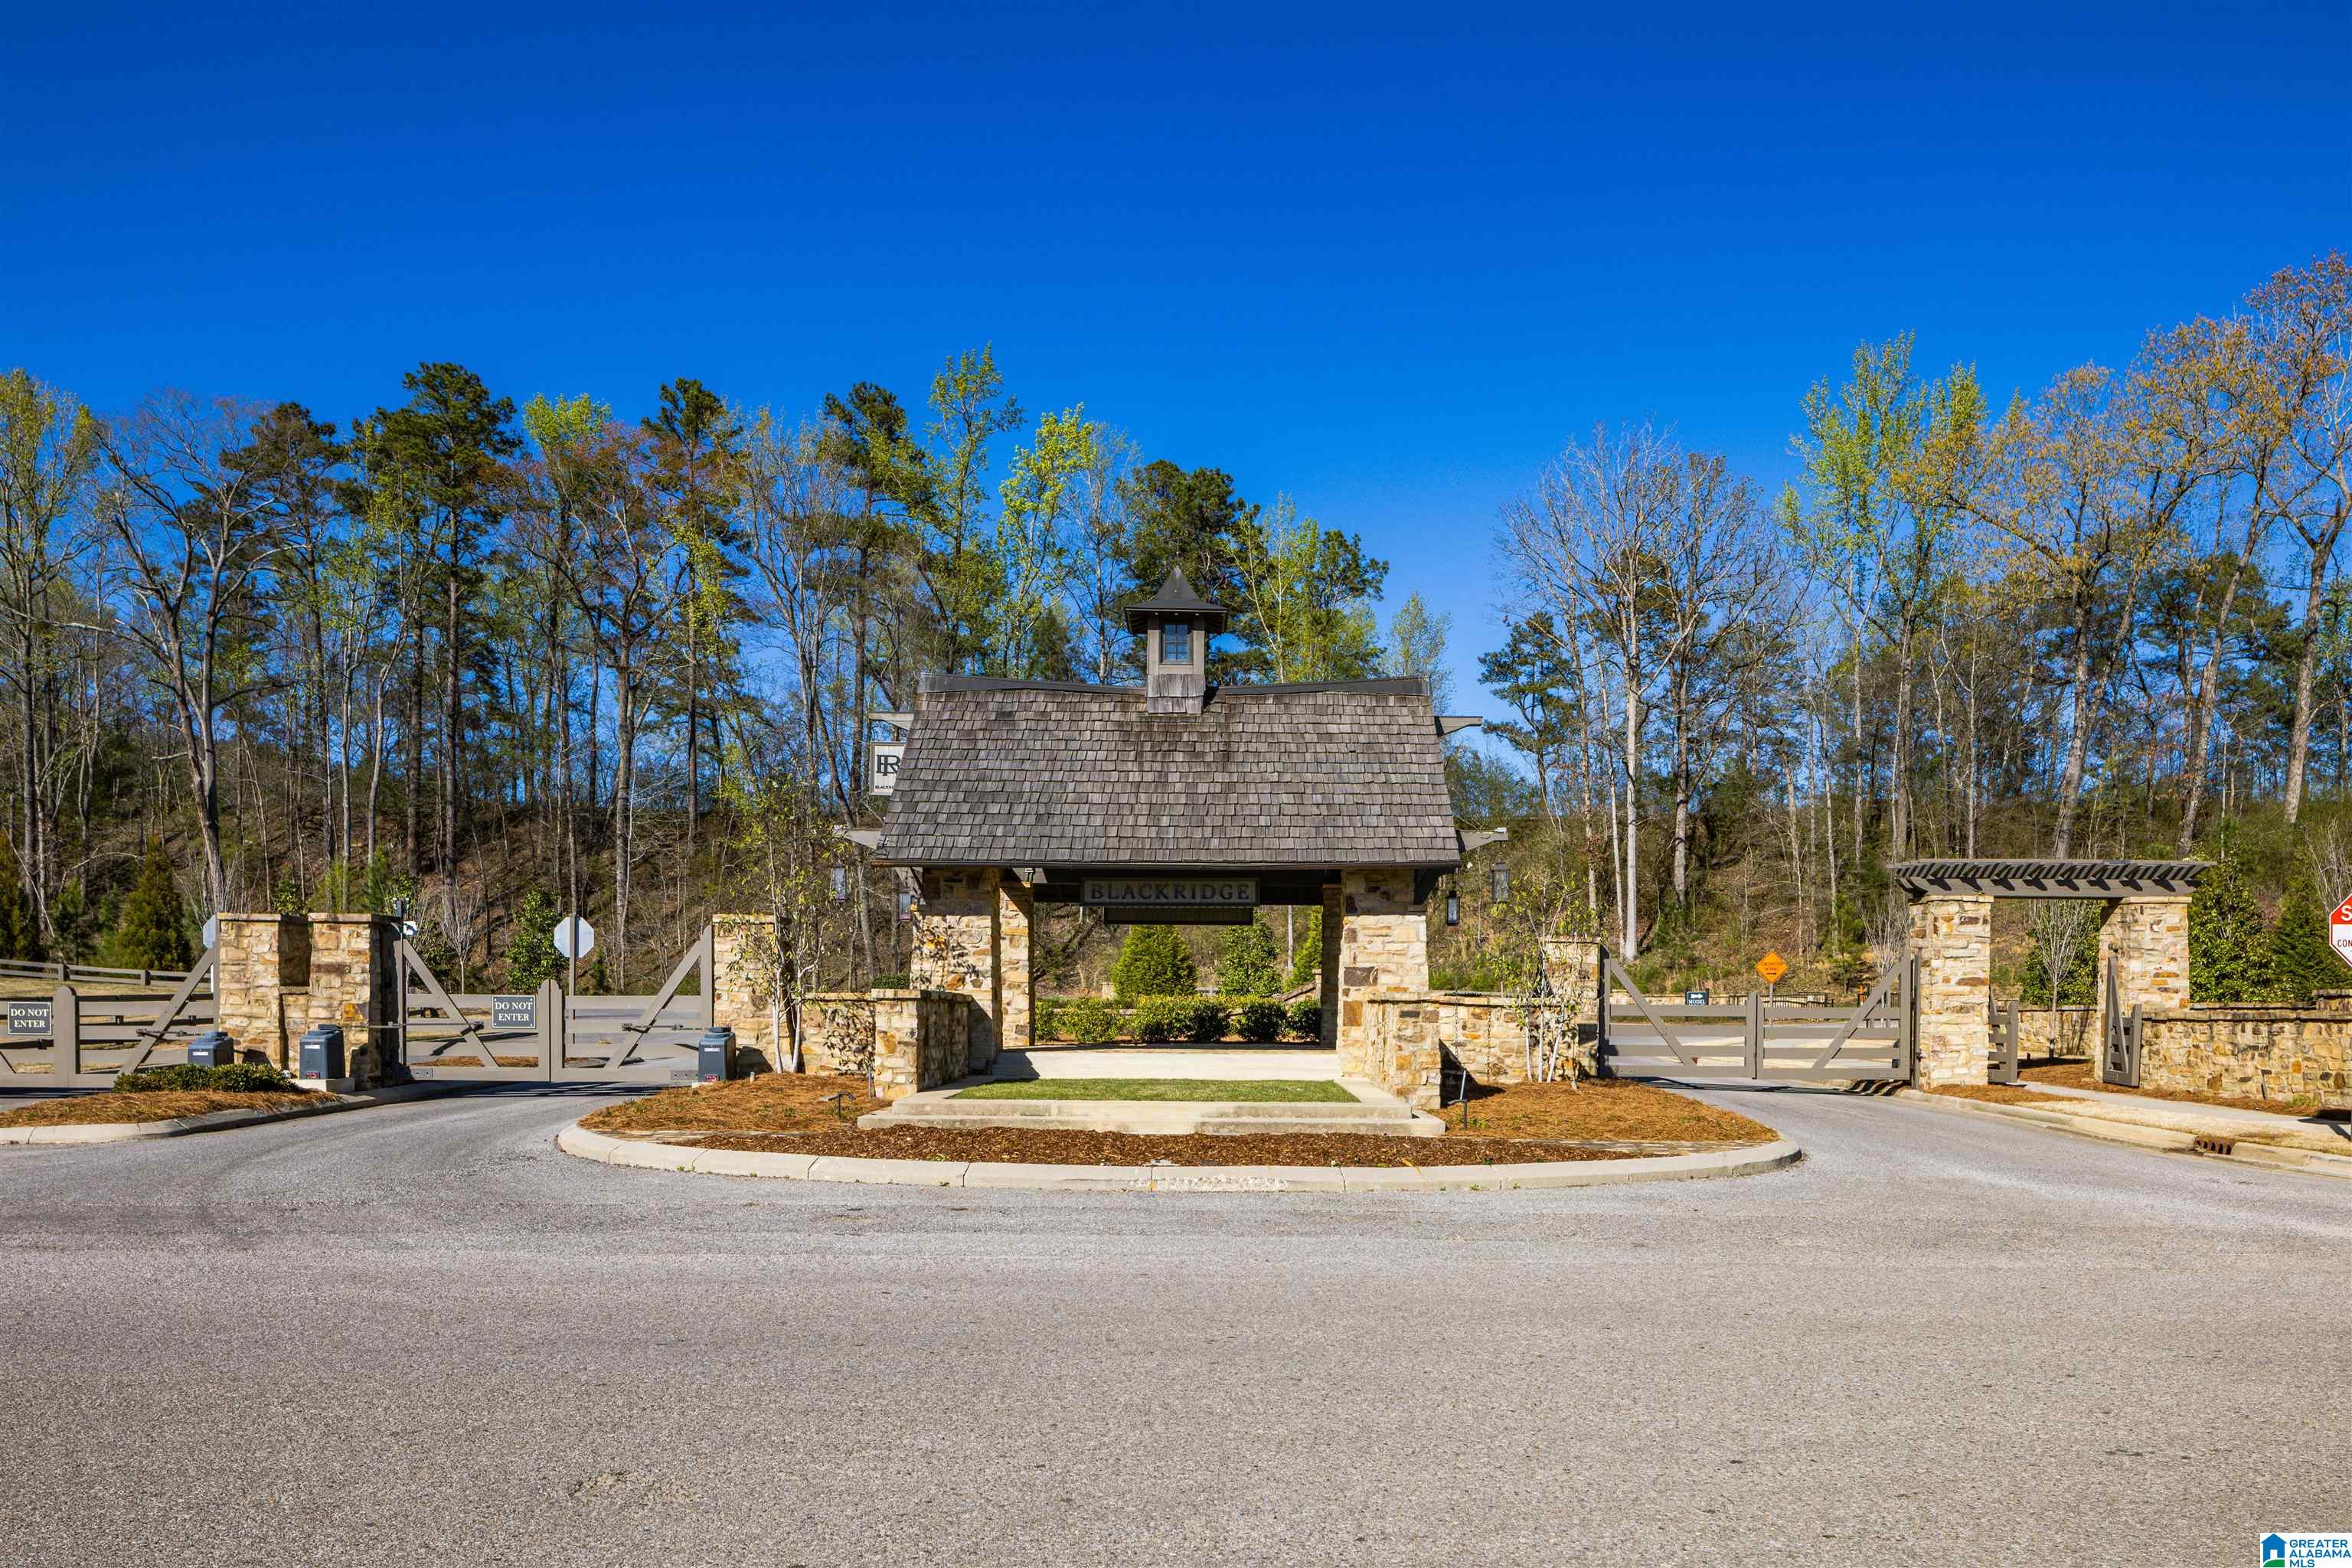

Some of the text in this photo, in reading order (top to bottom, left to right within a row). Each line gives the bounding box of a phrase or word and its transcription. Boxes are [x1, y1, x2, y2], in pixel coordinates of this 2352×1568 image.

[1090, 883, 1250, 900] BLACKRIDGE
[495, 1001, 533, 1011] DO NOT
[11, 1008, 49, 1017] DO NOT
[498, 1013, 529, 1021] ENTER
[14, 1019, 45, 1027] ENTER
